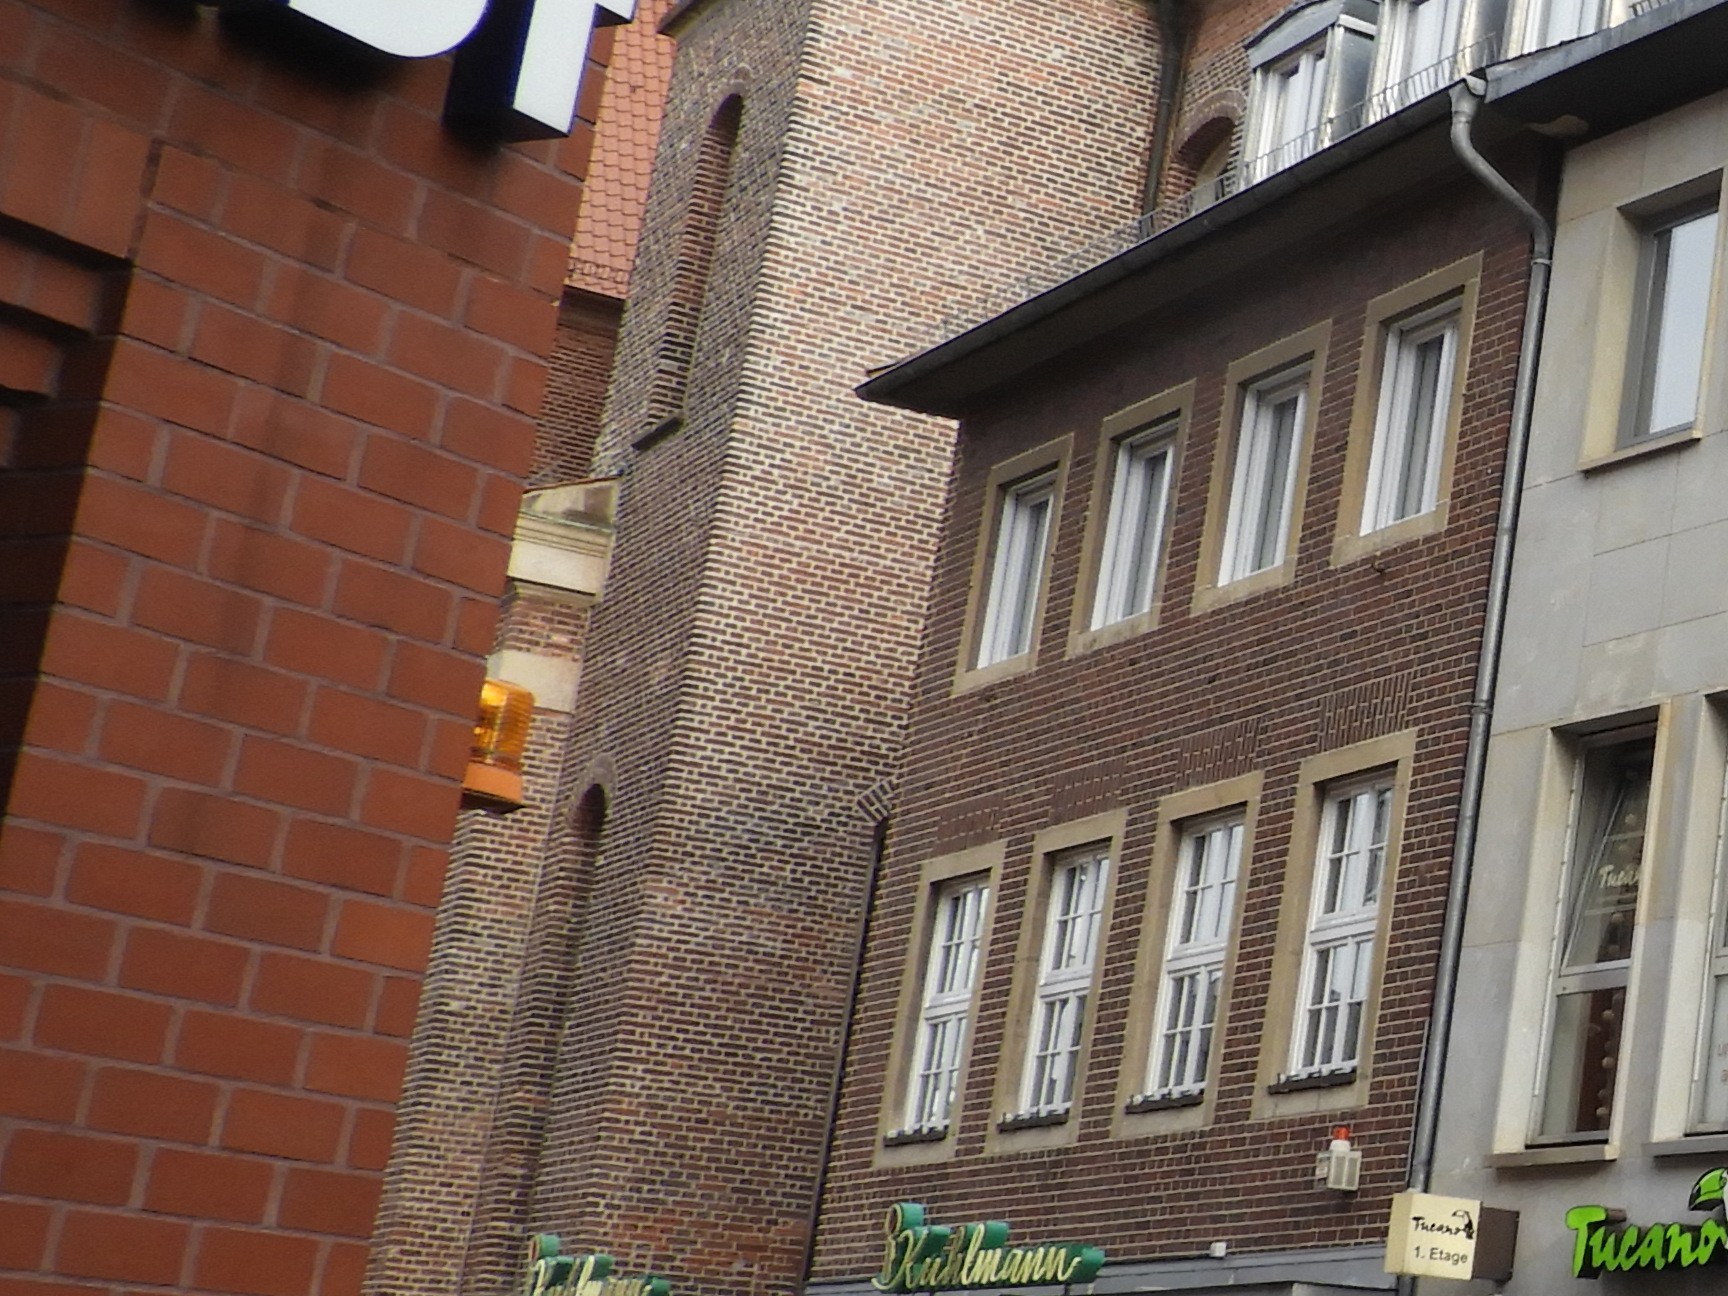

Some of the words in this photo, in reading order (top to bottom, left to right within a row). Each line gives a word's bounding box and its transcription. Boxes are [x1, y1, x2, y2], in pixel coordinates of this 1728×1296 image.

[1411, 1214, 1466, 1236] Tucano
[1564, 1204, 1728, 1279] Tucano
[1414, 1246, 1426, 1259] 1.
[1429, 1247, 1469, 1266] Etage
